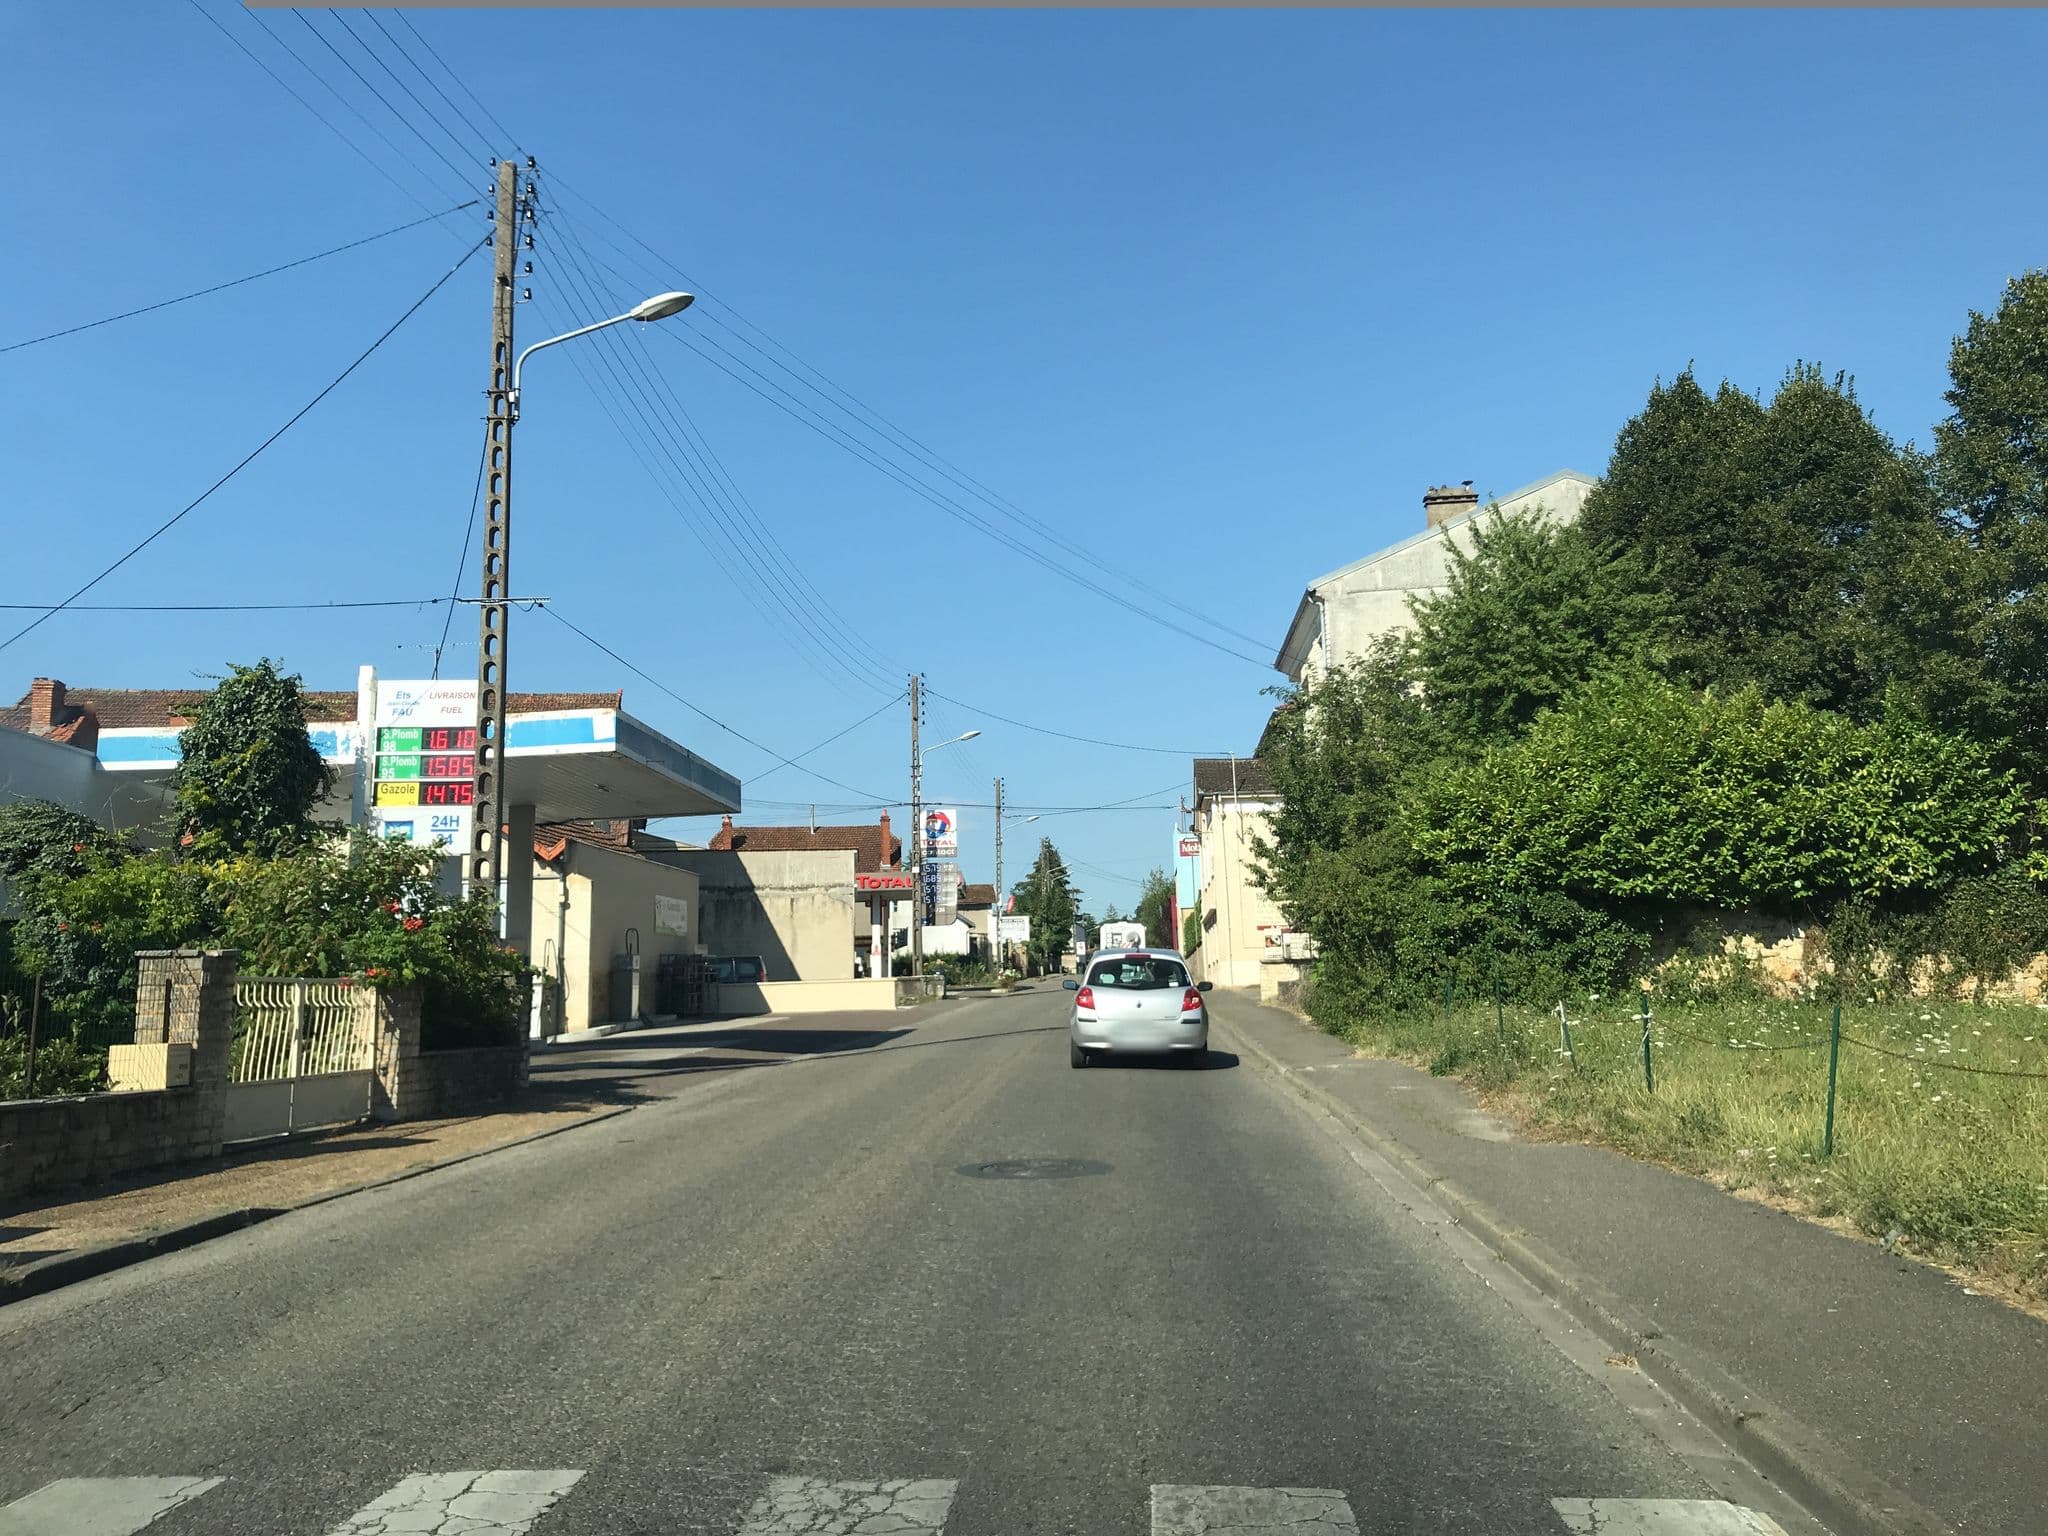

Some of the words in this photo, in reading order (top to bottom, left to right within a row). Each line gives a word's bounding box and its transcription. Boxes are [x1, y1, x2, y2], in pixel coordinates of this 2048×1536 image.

[381, 784, 415, 794] Gazole
[431, 815, 460, 828] 24H
[856, 876, 912, 889] TOTAL
